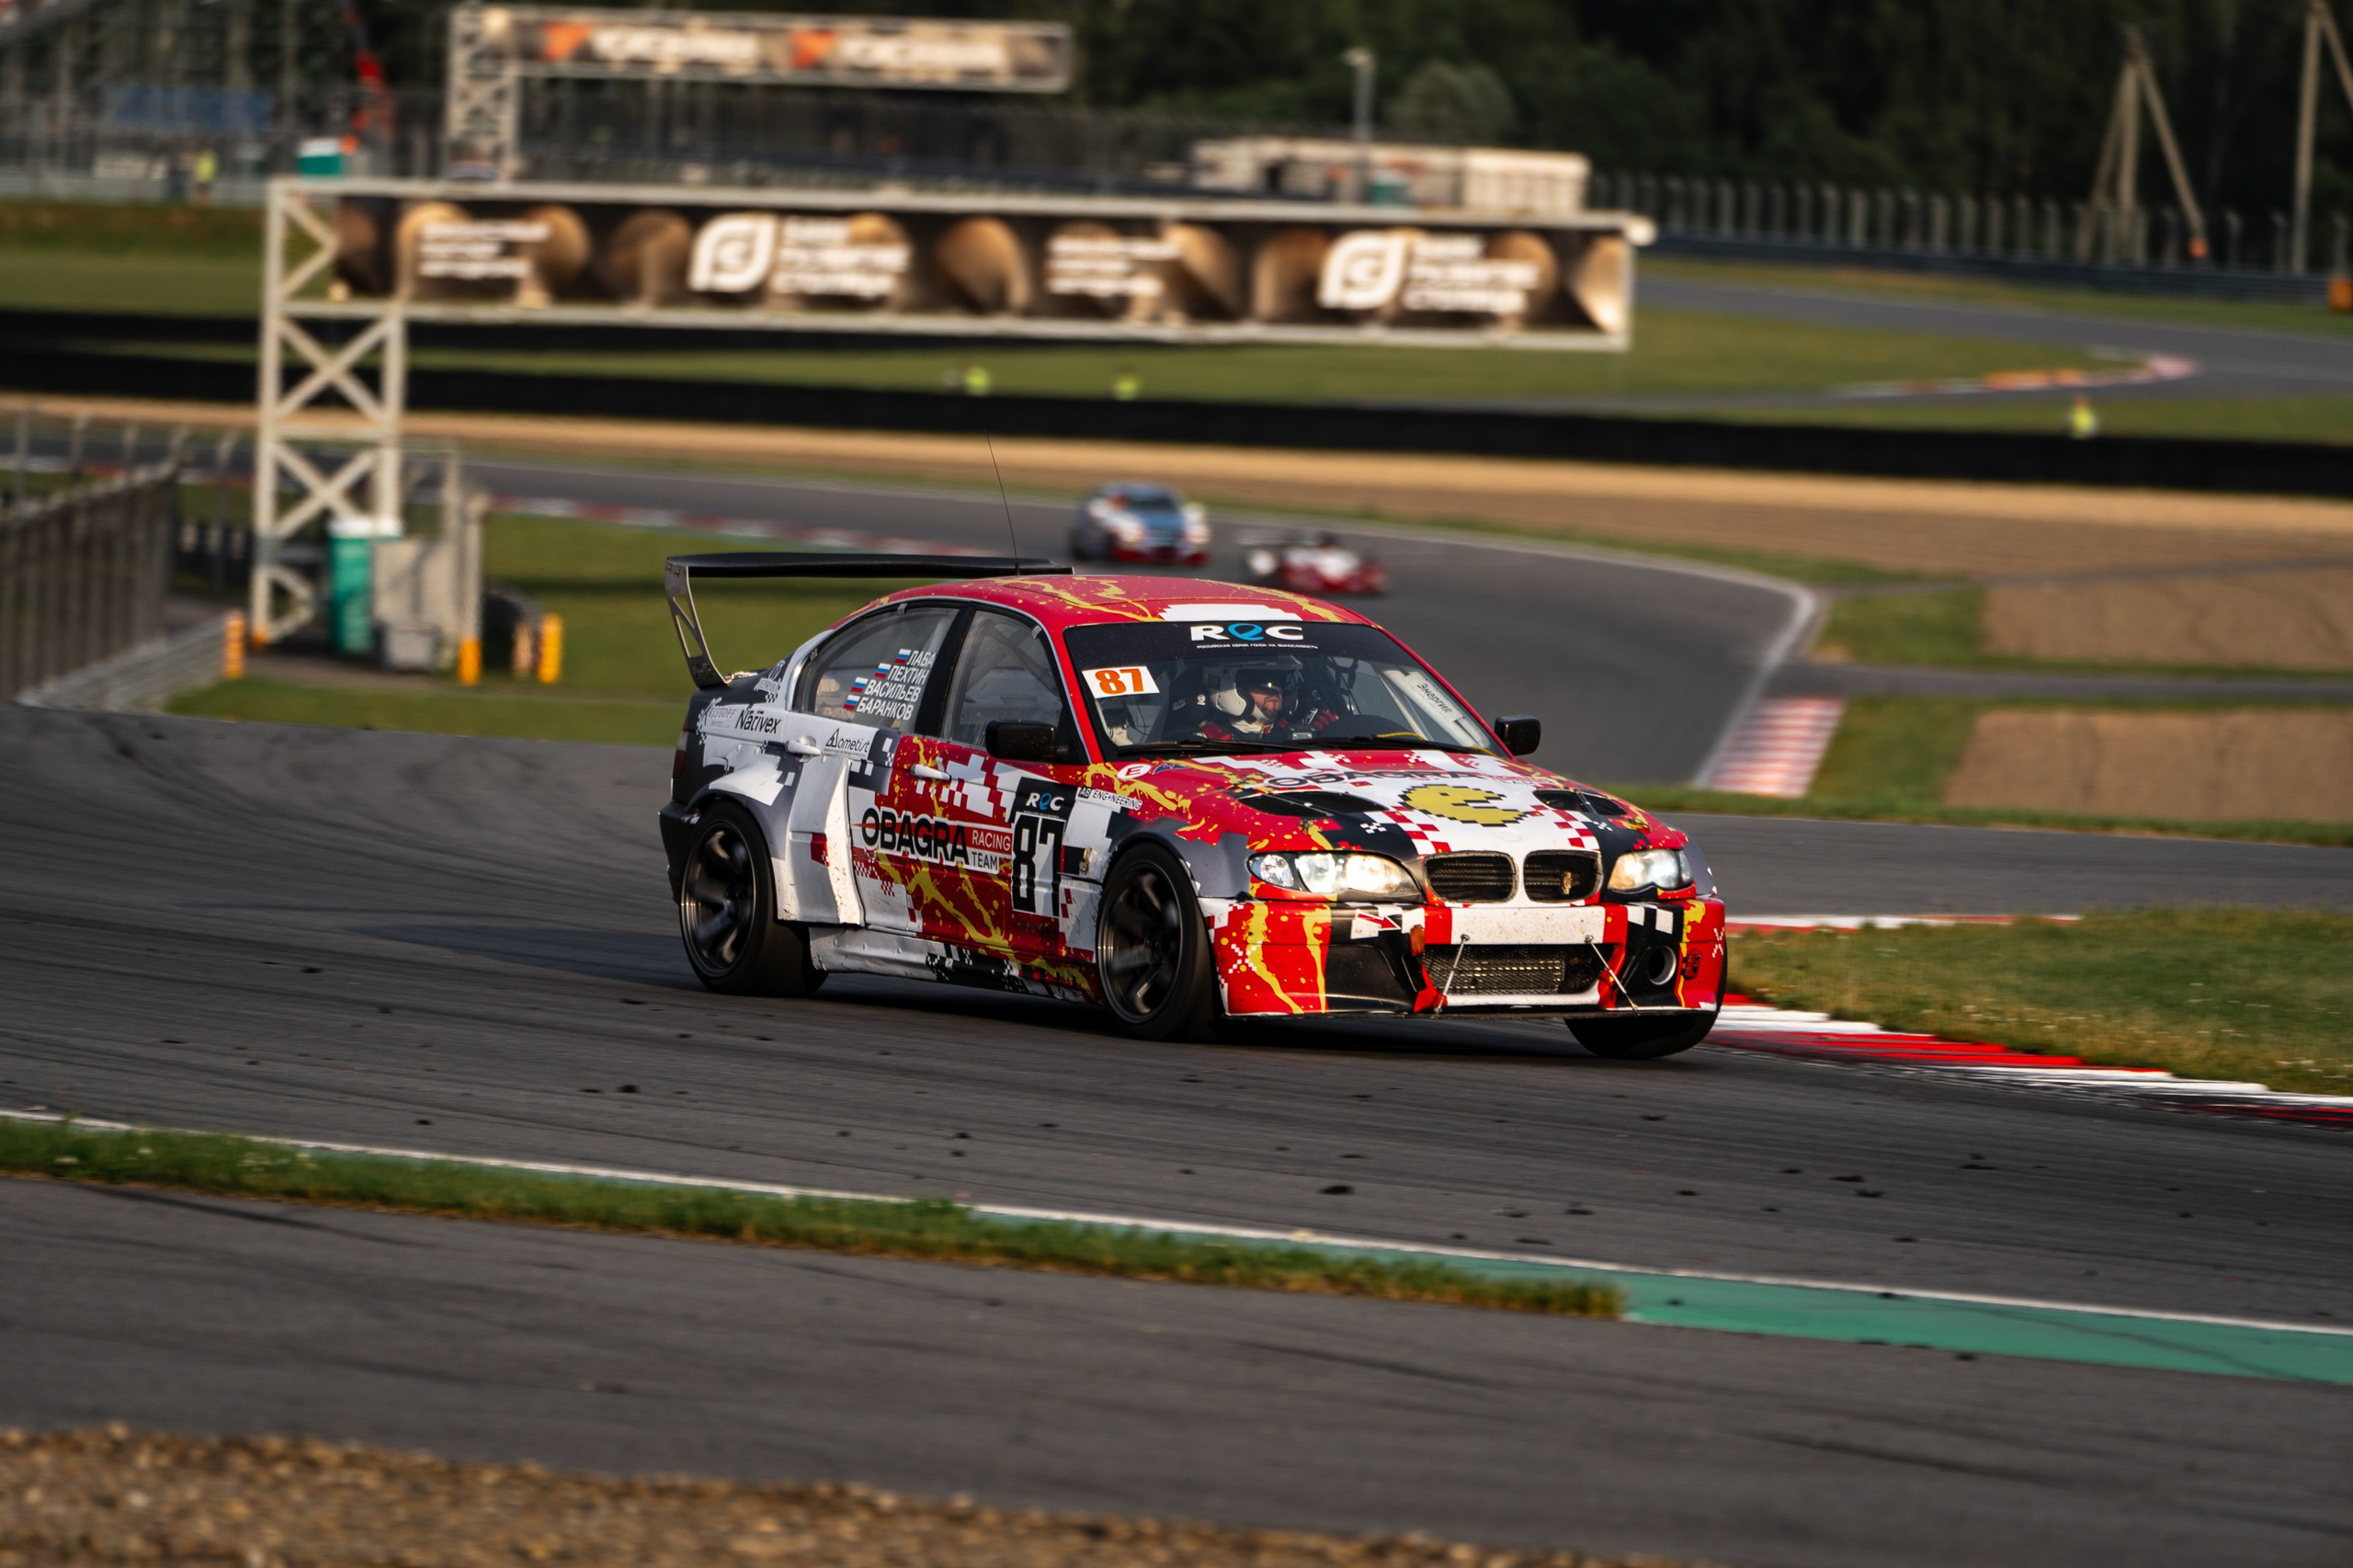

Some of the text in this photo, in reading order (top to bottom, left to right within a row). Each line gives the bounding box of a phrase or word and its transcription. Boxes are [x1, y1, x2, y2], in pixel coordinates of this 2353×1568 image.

[906, 651, 937, 667] ЛАБА
[888, 665, 929, 685] ПЕХТИН
[1095, 668, 1144, 695] 87
[864, 679, 922, 702] ВАСИЛЬЕВ
[1416, 683, 1452, 713] Энергия
[856, 697, 915, 721] БАРАНКОВ
[861, 808, 970, 865] OBAGRA
[972, 830, 1011, 851] RACING
[972, 851, 998, 871] TEAM
[1013, 814, 1066, 917] 87
